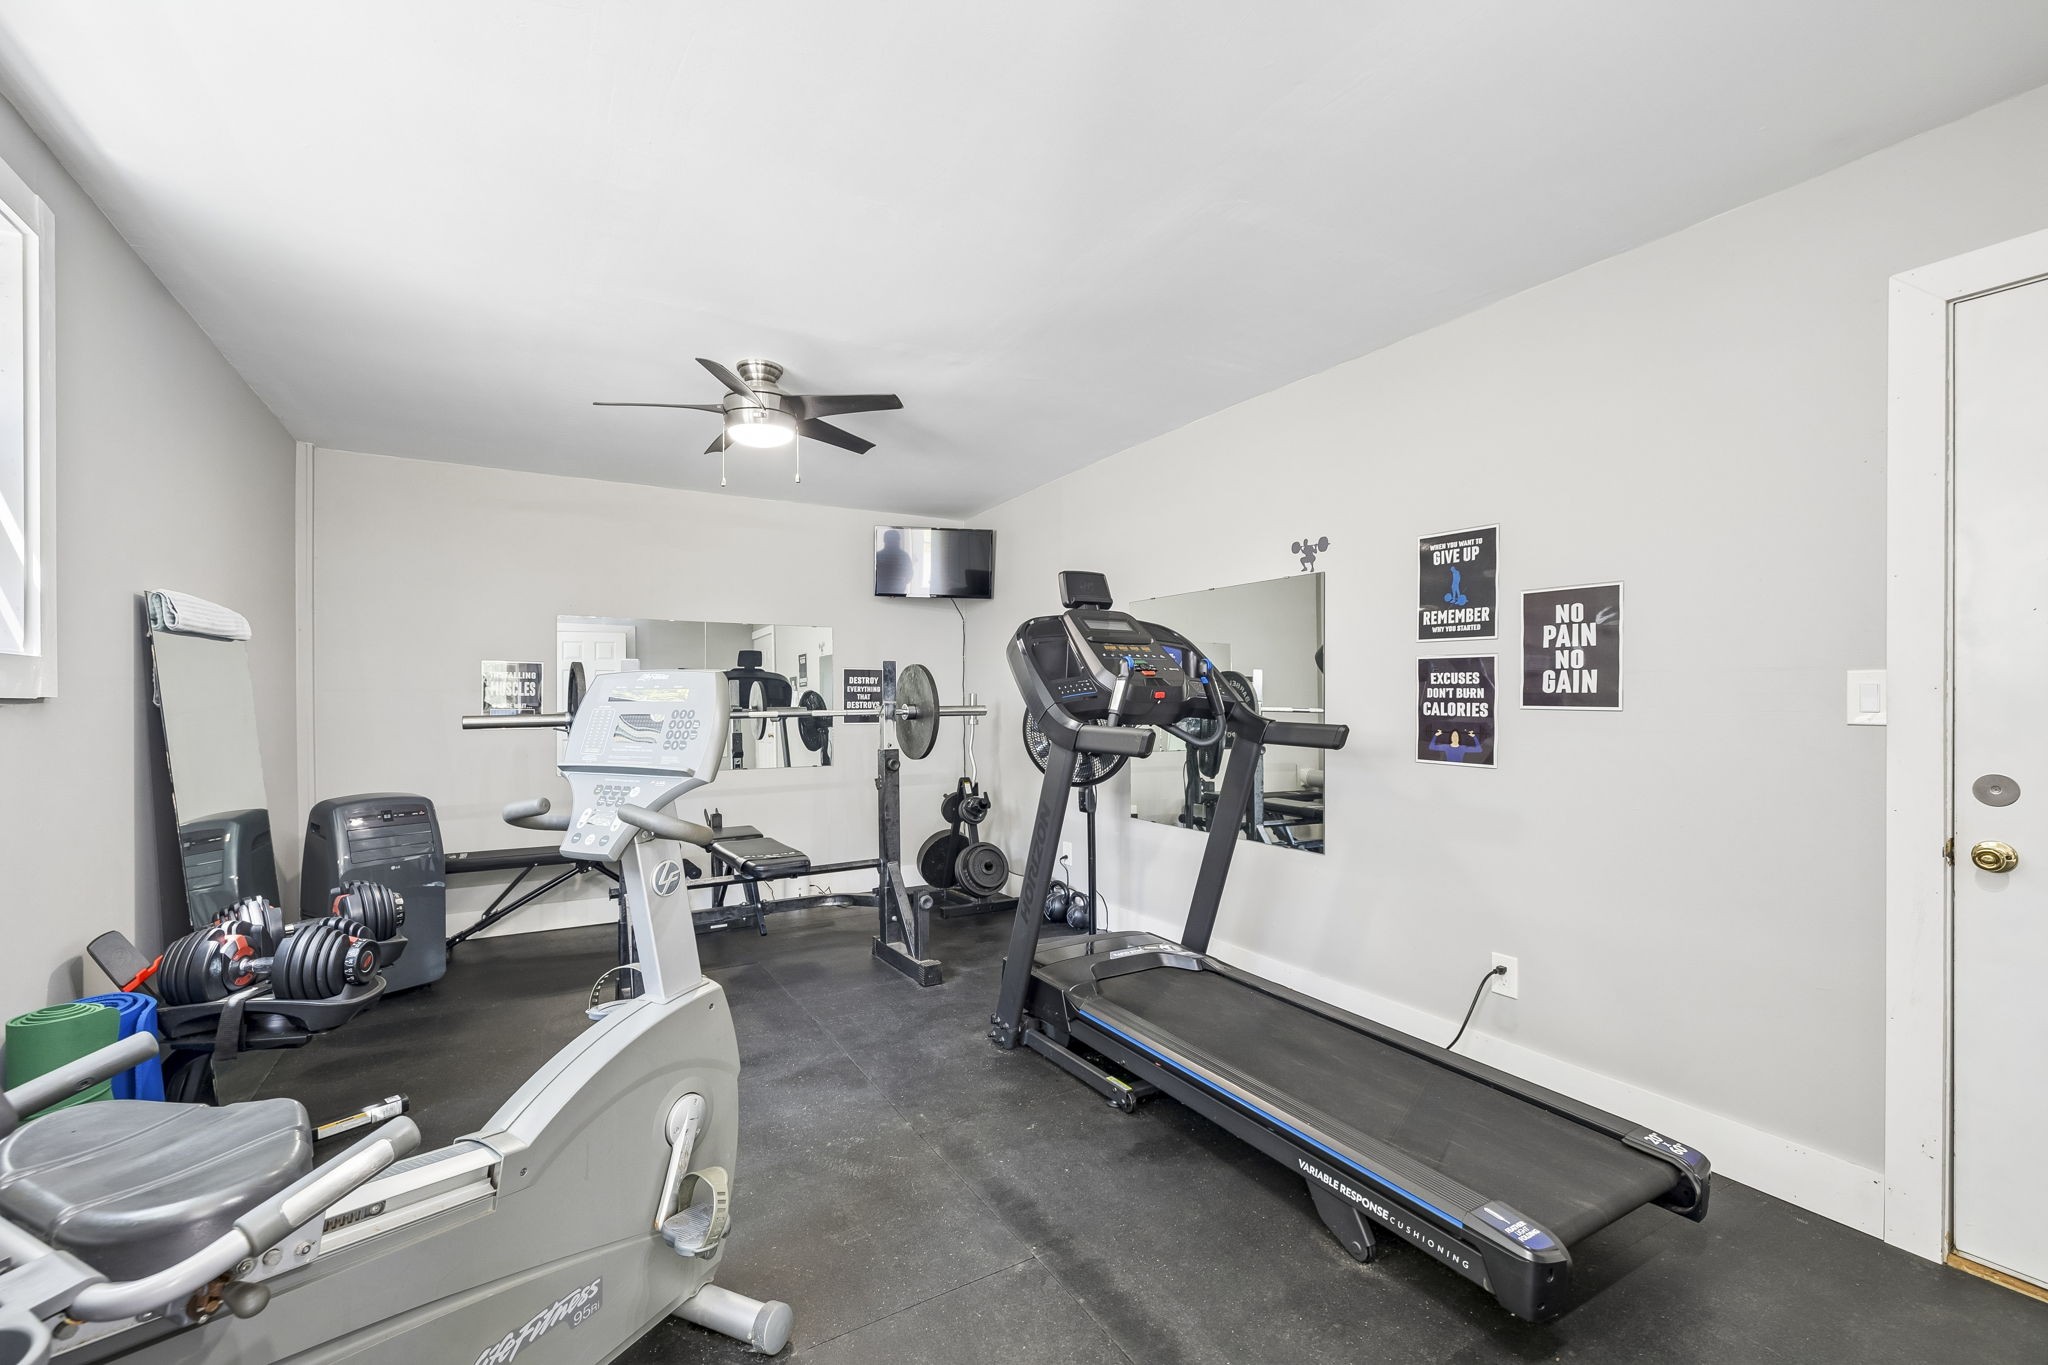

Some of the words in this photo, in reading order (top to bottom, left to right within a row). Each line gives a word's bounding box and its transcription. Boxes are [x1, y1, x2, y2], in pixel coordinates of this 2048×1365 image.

[1430, 543, 1446, 551] WHEN
[1458, 539, 1475, 547] WANT
[1433, 548, 1460, 566] GIVE
[1463, 546, 1480, 562] UP
[1423, 607, 1490, 625] REMEMBER
[1555, 603, 1584, 623] NO
[1543, 622, 1597, 648] PAIN
[1555, 649, 1584, 669] NO
[849, 676, 878, 684] DESTROY
[1430, 672, 1480, 684] EXCUSES
[1542, 669, 1598, 693] GAIN
[490, 681, 536, 696] MUSCLES
[1427, 688, 1454, 698] DON'T
[1456, 688, 1484, 698] BURN
[846, 701, 880, 709] DESTROYS
[1423, 702, 1488, 717] CALORIES
[1020, 803, 1051, 925] HORIZON
[1298, 1158, 1339, 1190] VARIABLE
[1339, 1183, 1389, 1220] RESPONSE
[1389, 1216, 1470, 1269] CUSHIONING
